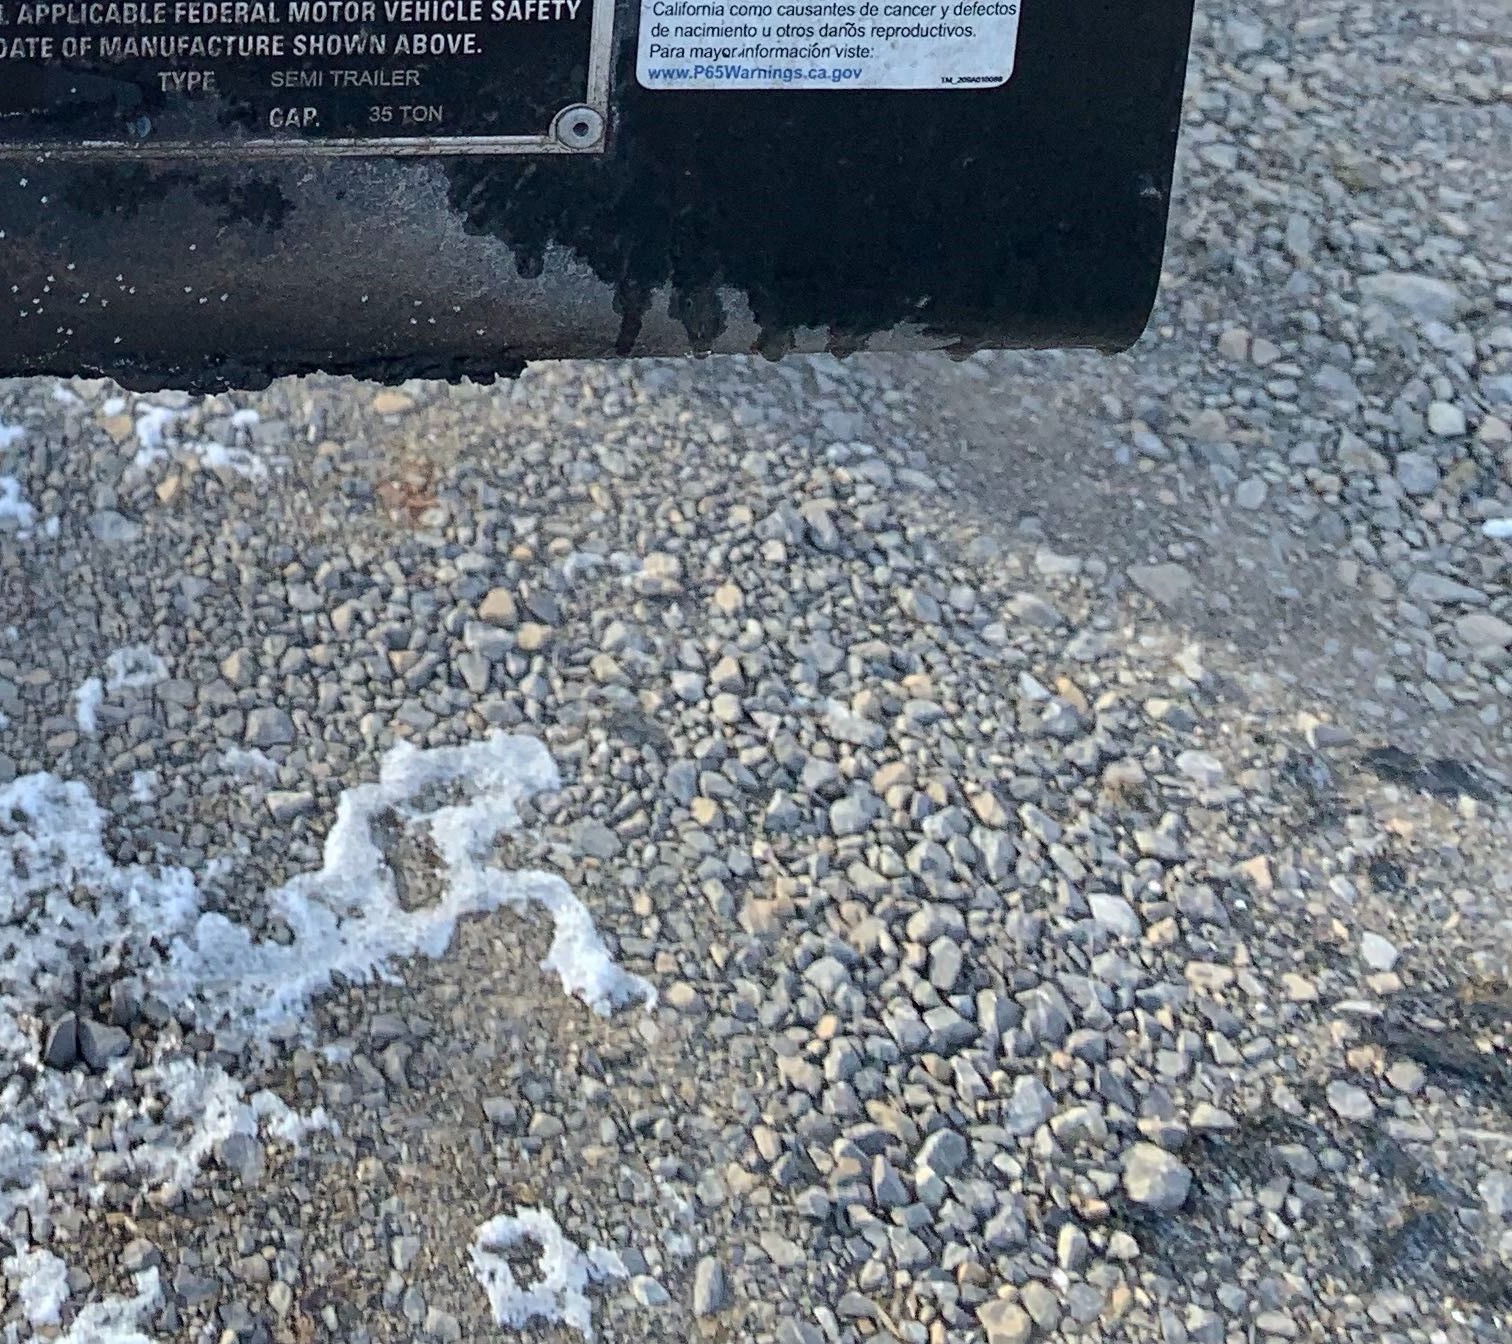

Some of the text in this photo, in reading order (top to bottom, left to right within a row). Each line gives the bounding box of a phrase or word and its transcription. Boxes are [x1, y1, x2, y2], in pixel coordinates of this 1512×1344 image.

[16, 2, 166, 26] APPLICABLE
[174, 2, 280, 24] FEDERAL
[288, 1, 376, 23] MOTOR
[384, 0, 483, 22] VEHICLE
[490, 0, 582, 21] SAFETY
[652, 1, 1017, 20] California como causantes de cancer y defectos
[651, 23, 671, 38] de
[674, 22, 758, 39] nacimiento
[762, 26, 772, 39] u
[776, 24, 815, 39] otros
[870, 23, 977, 42] reproductivos.
[61, 36, 92, 58] OF
[99, 35, 285, 58] MANUFACTURE
[292, 34, 387, 57] SHOWN
[393, 33, 483, 55] ABOVE.
[649, 43, 875, 63] Para mayor información viste:
[157, 71, 216, 93] TYPE
[270, 71, 323, 89] SEMI
[329, 69, 420, 88] TRAILER
[648, 65, 863, 82] www.P65Warnings.ca.gov
[368, 105, 393, 123] 35
[400, 104, 443, 123] TON
